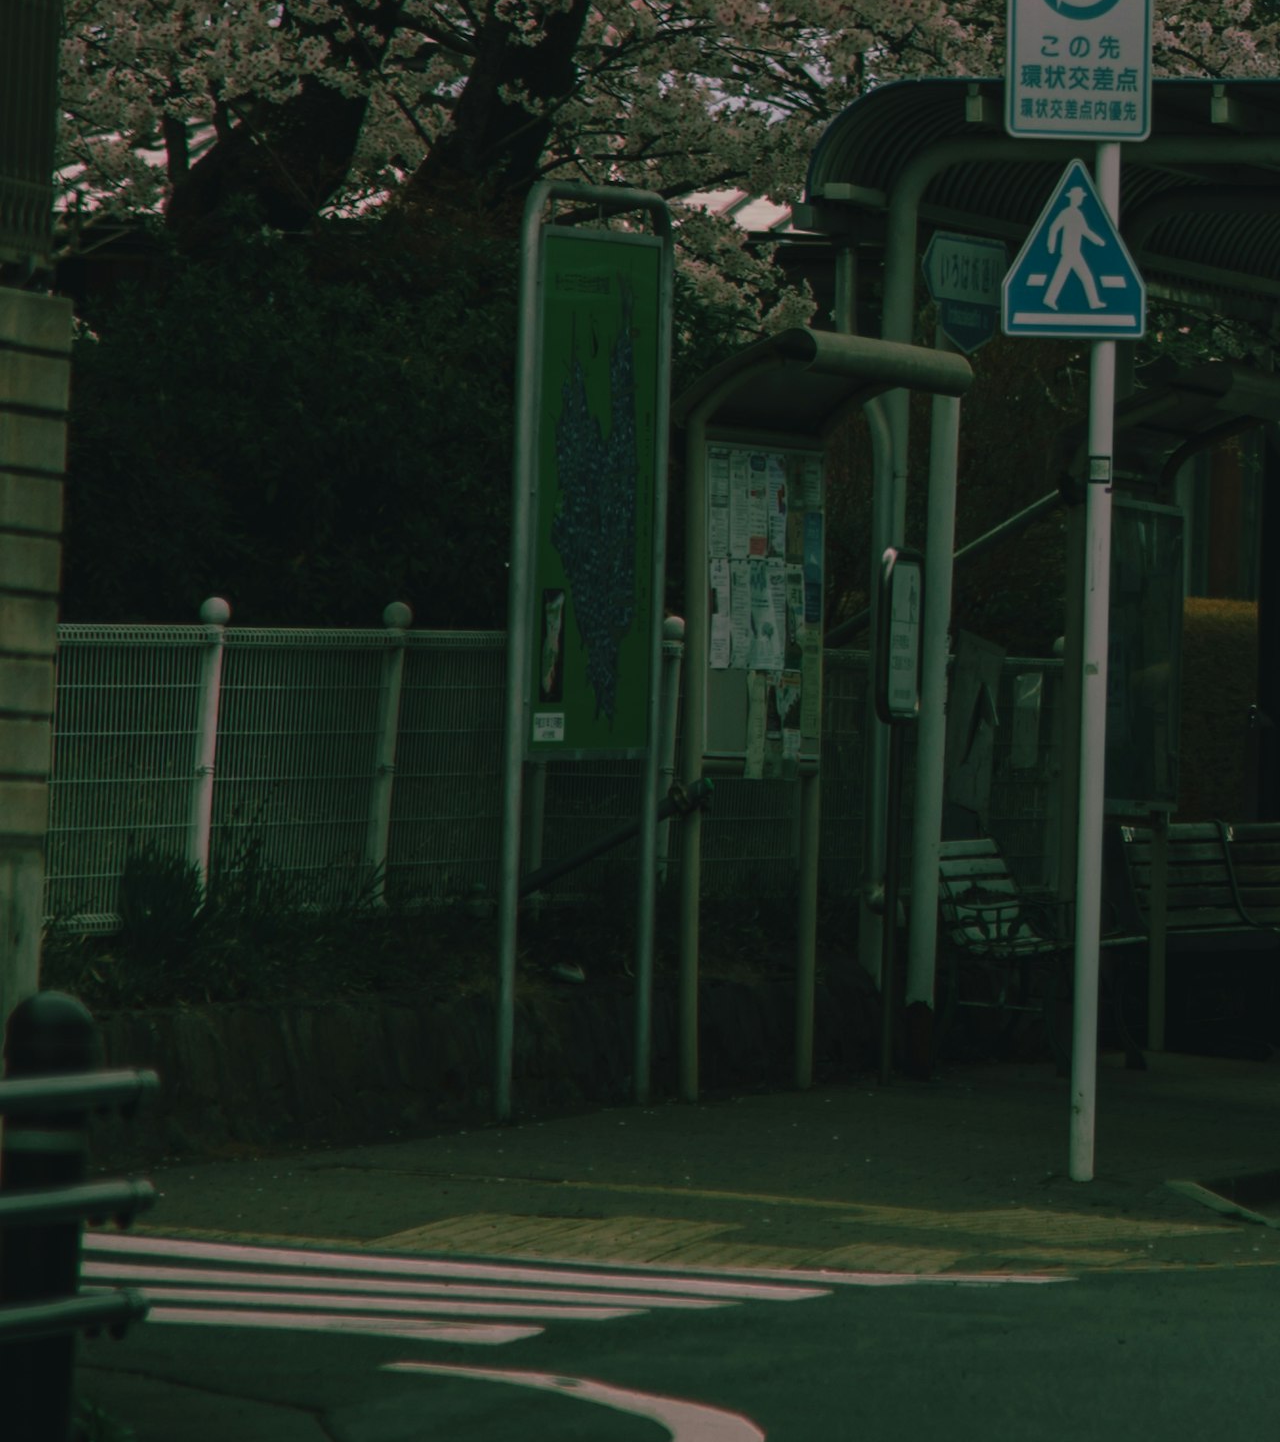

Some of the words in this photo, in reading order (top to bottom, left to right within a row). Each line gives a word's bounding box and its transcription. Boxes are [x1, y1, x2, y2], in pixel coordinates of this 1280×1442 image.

[1041, 35, 1120, 60] この先
[1019, 63, 1139, 93] 環状交差点
[1020, 98, 1137, 122] 環状交差点内優先
